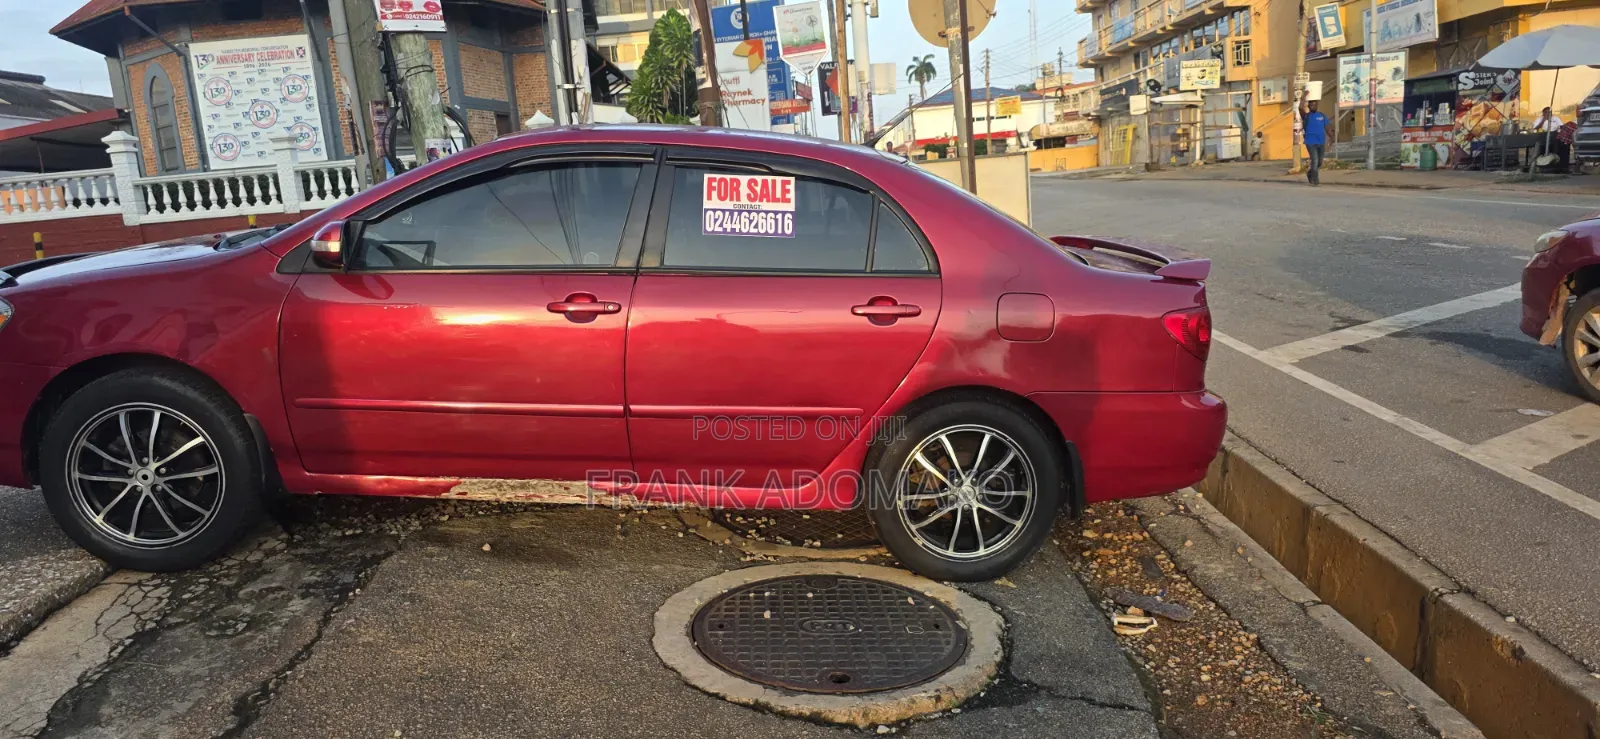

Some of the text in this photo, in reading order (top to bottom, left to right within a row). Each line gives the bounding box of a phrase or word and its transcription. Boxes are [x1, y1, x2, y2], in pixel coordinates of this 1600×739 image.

[216, 49, 295, 65] ANNIVERSARY CELEBRATION
[721, 88, 753, 99] Raynek
[723, 97, 766, 107] Pharmacy
[707, 177, 791, 203] FOR SALE
[705, 210, 793, 234] 0244626616
